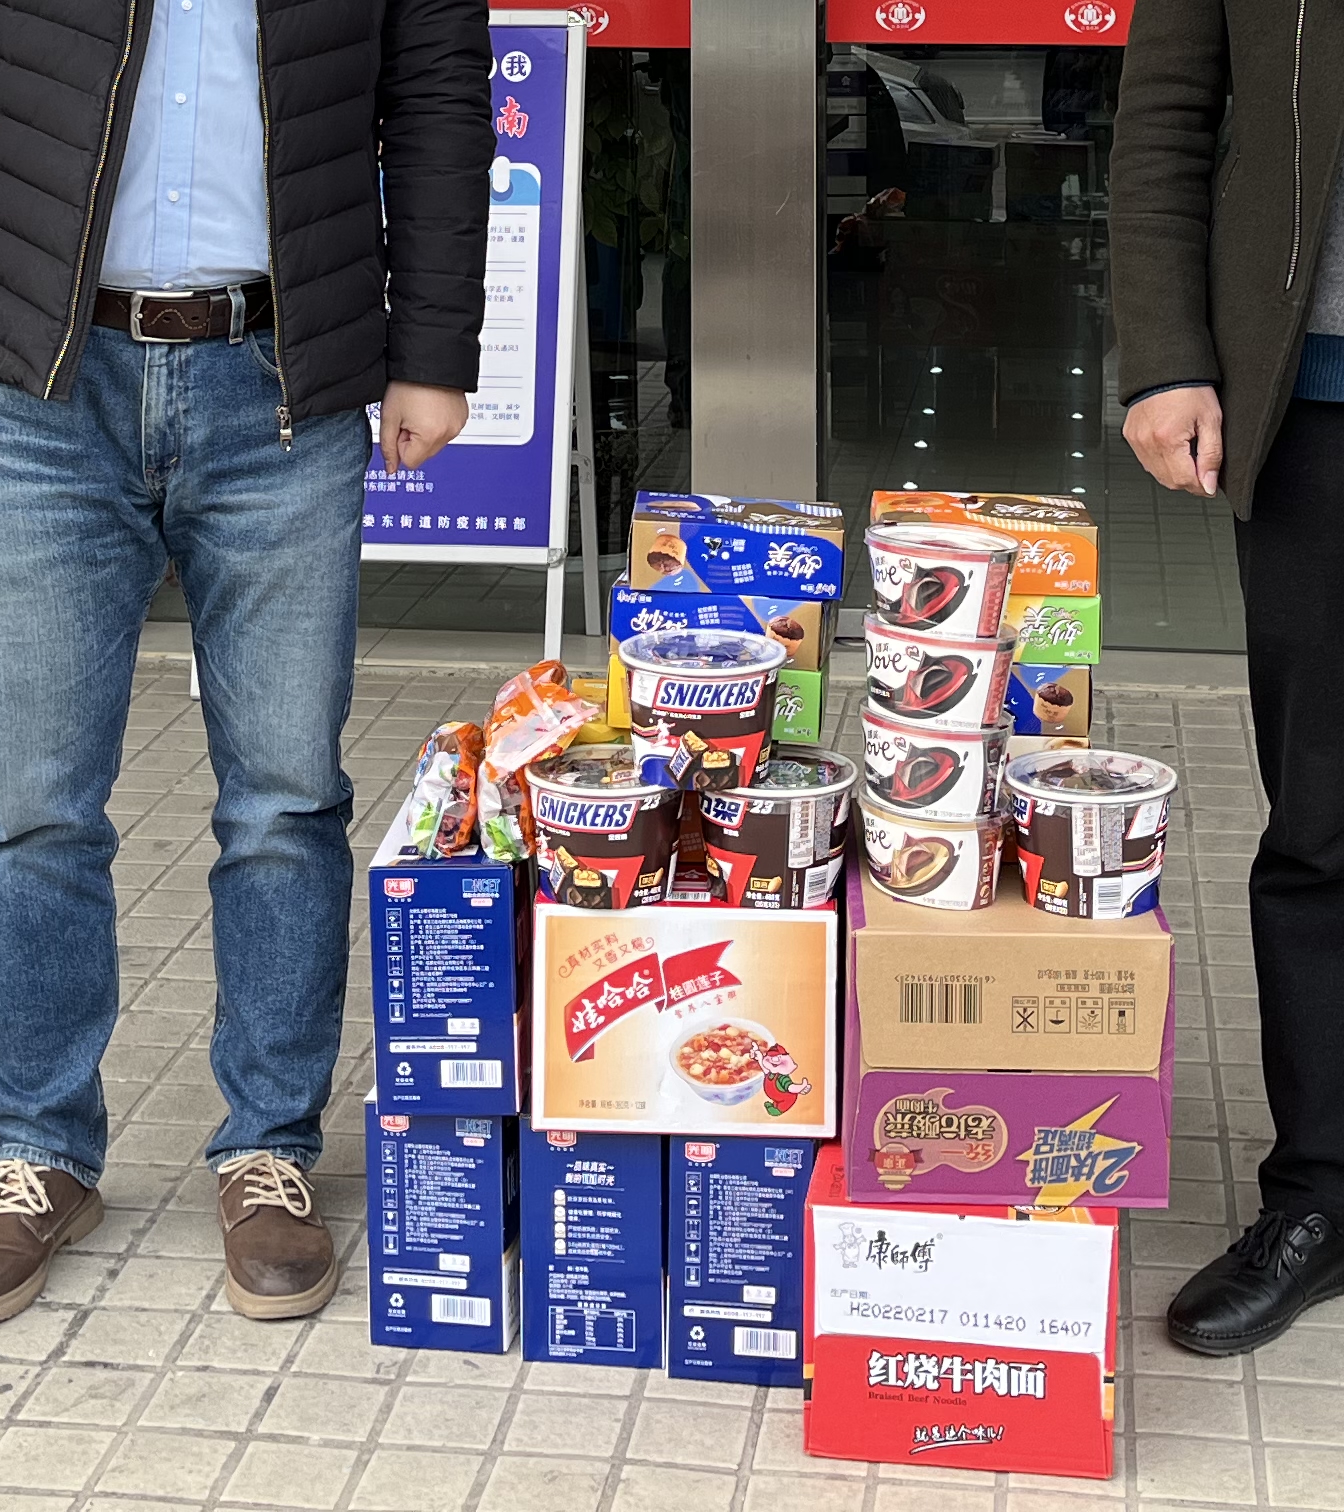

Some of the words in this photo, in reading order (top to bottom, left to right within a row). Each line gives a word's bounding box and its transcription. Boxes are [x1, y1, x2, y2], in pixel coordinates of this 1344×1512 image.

[504, 53, 528, 77] 我
[496, 95, 529, 139] 南
[363, 514, 527, 531] 娄东街道防疫指挥部
[659, 678, 762, 708] SNICKERS
[538, 796, 630, 828] SNICKERS
[749, 799, 775, 815] 23
[571, 970, 654, 1034] 娃哈哈
[883, 1112, 996, 1140] 老坛酸菜
[940, 1142, 996, 1163] 统一
[1033, 1128, 1097, 1152] 超满足
[1027, 1145, 1136, 1195] 2块面饼
[959, 1311, 1026, 1332] 011420
[867, 1349, 1047, 1399] 红烧牛肉面
[868, 1390, 904, 1403] Braised
[907, 1394, 930, 1404] Beef
[932, 1395, 968, 1406] Noodle
